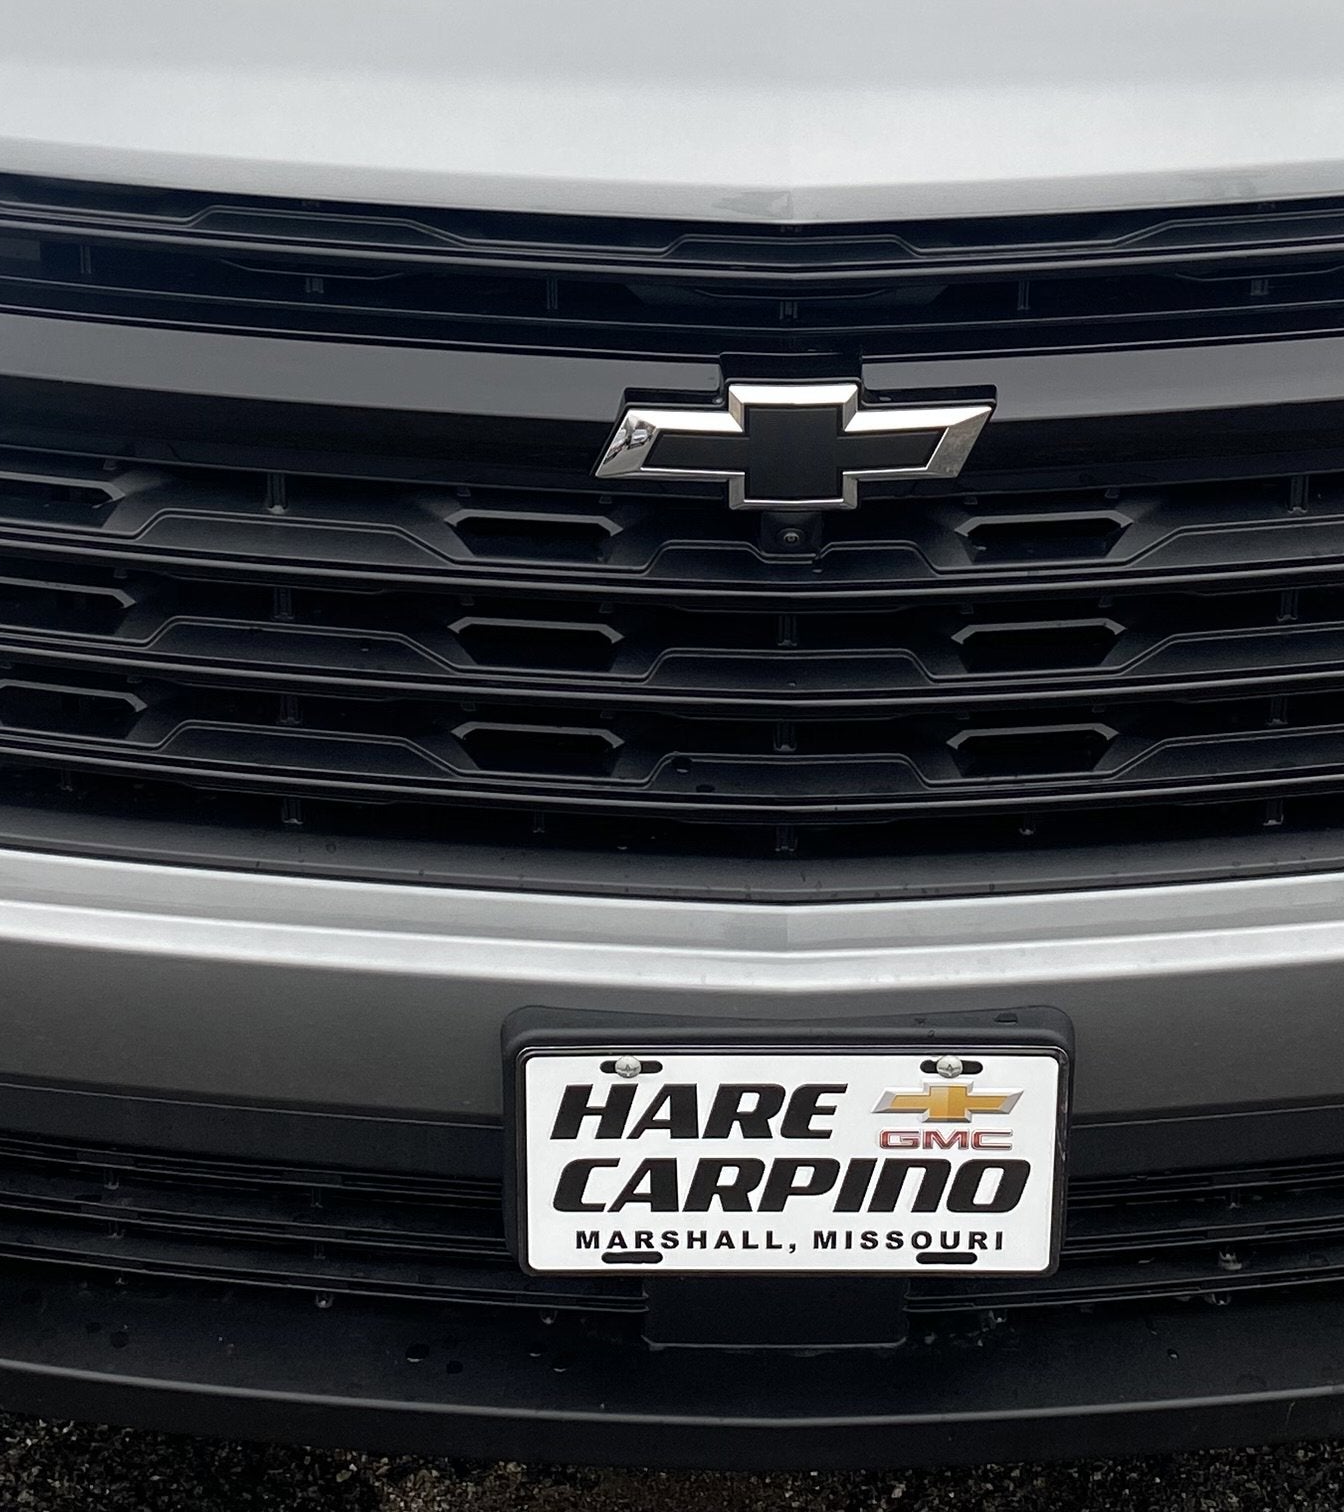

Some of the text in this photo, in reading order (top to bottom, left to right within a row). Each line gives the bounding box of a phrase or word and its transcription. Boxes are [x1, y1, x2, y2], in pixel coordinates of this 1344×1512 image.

[549, 1082, 849, 1140] HARE
[878, 1127, 1015, 1151] GMC
[552, 1156, 1032, 1214] CARPINO
[575, 1229, 1005, 1255] MARSHALL, MISSOURI
